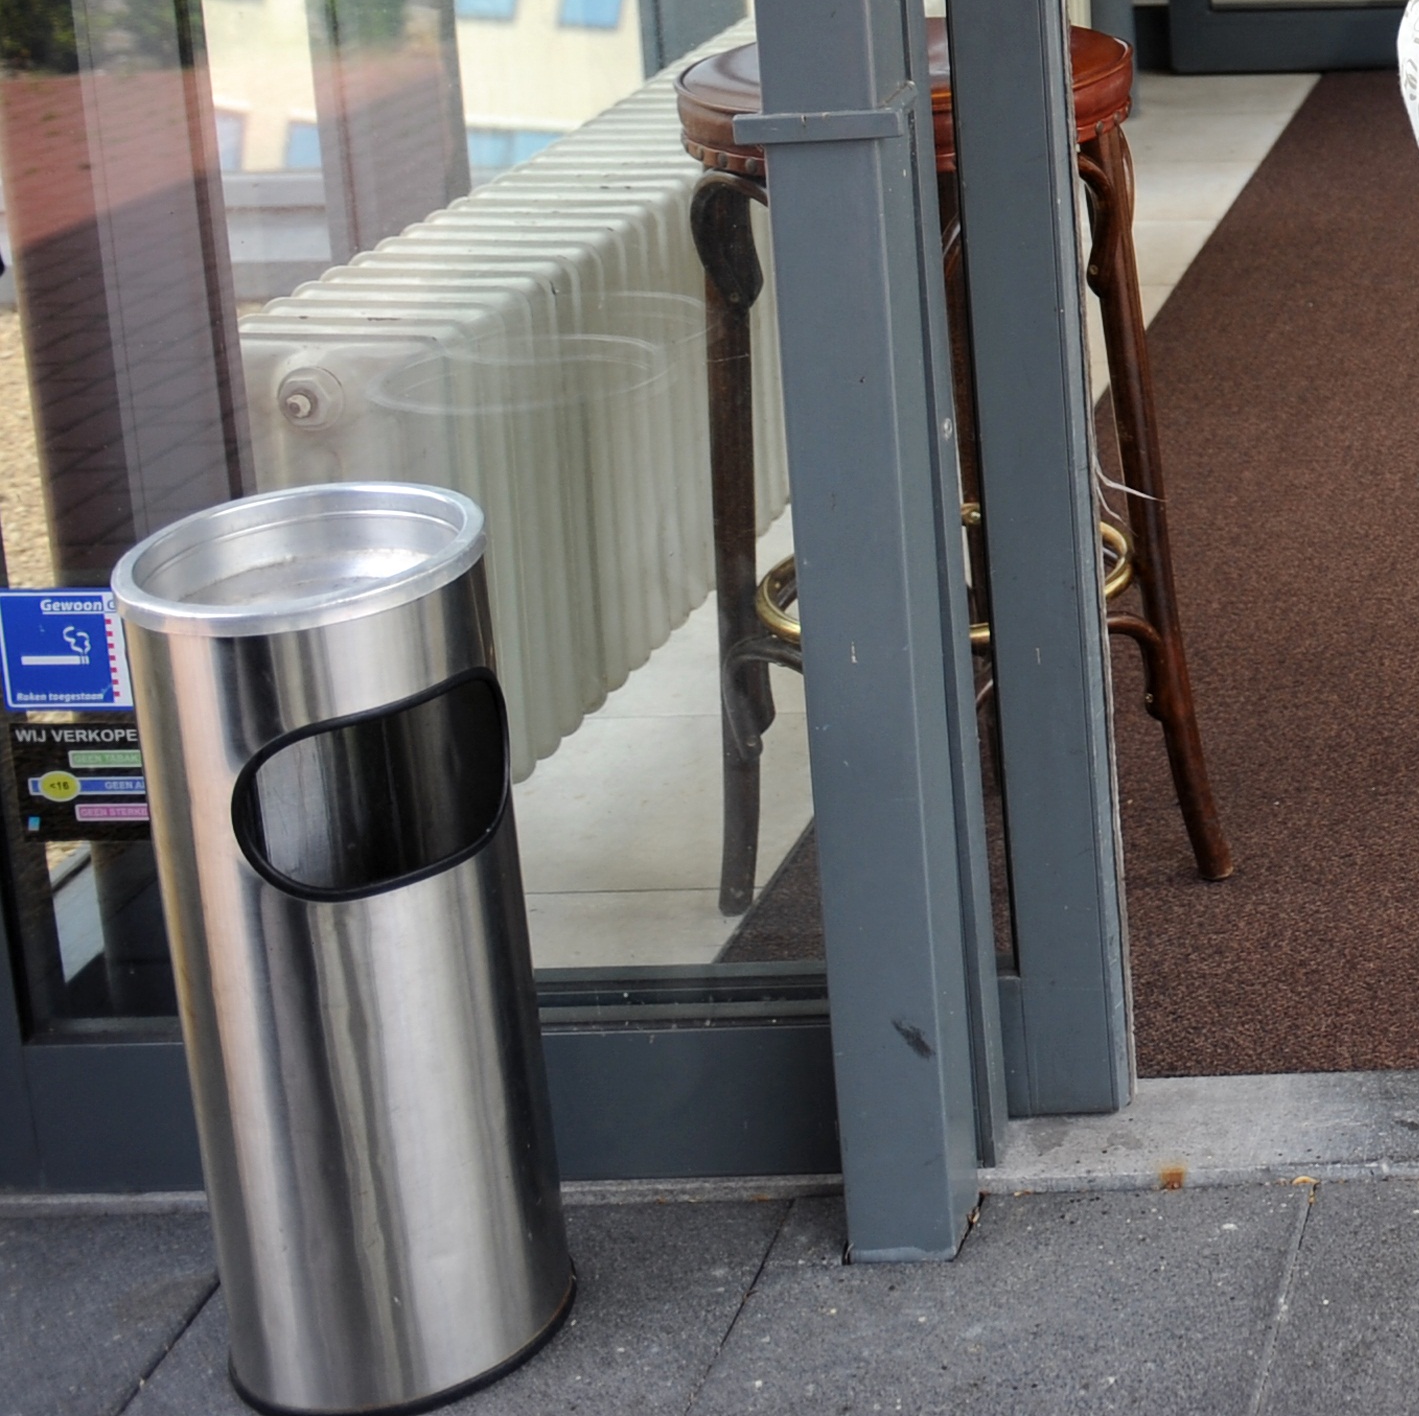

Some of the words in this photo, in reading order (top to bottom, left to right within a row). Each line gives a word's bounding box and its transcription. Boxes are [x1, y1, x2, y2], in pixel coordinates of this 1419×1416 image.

[40, 599, 102, 612] Gewoon
[15, 730, 46, 742] WIJ
[51, 729, 138, 742] VERKOPE
